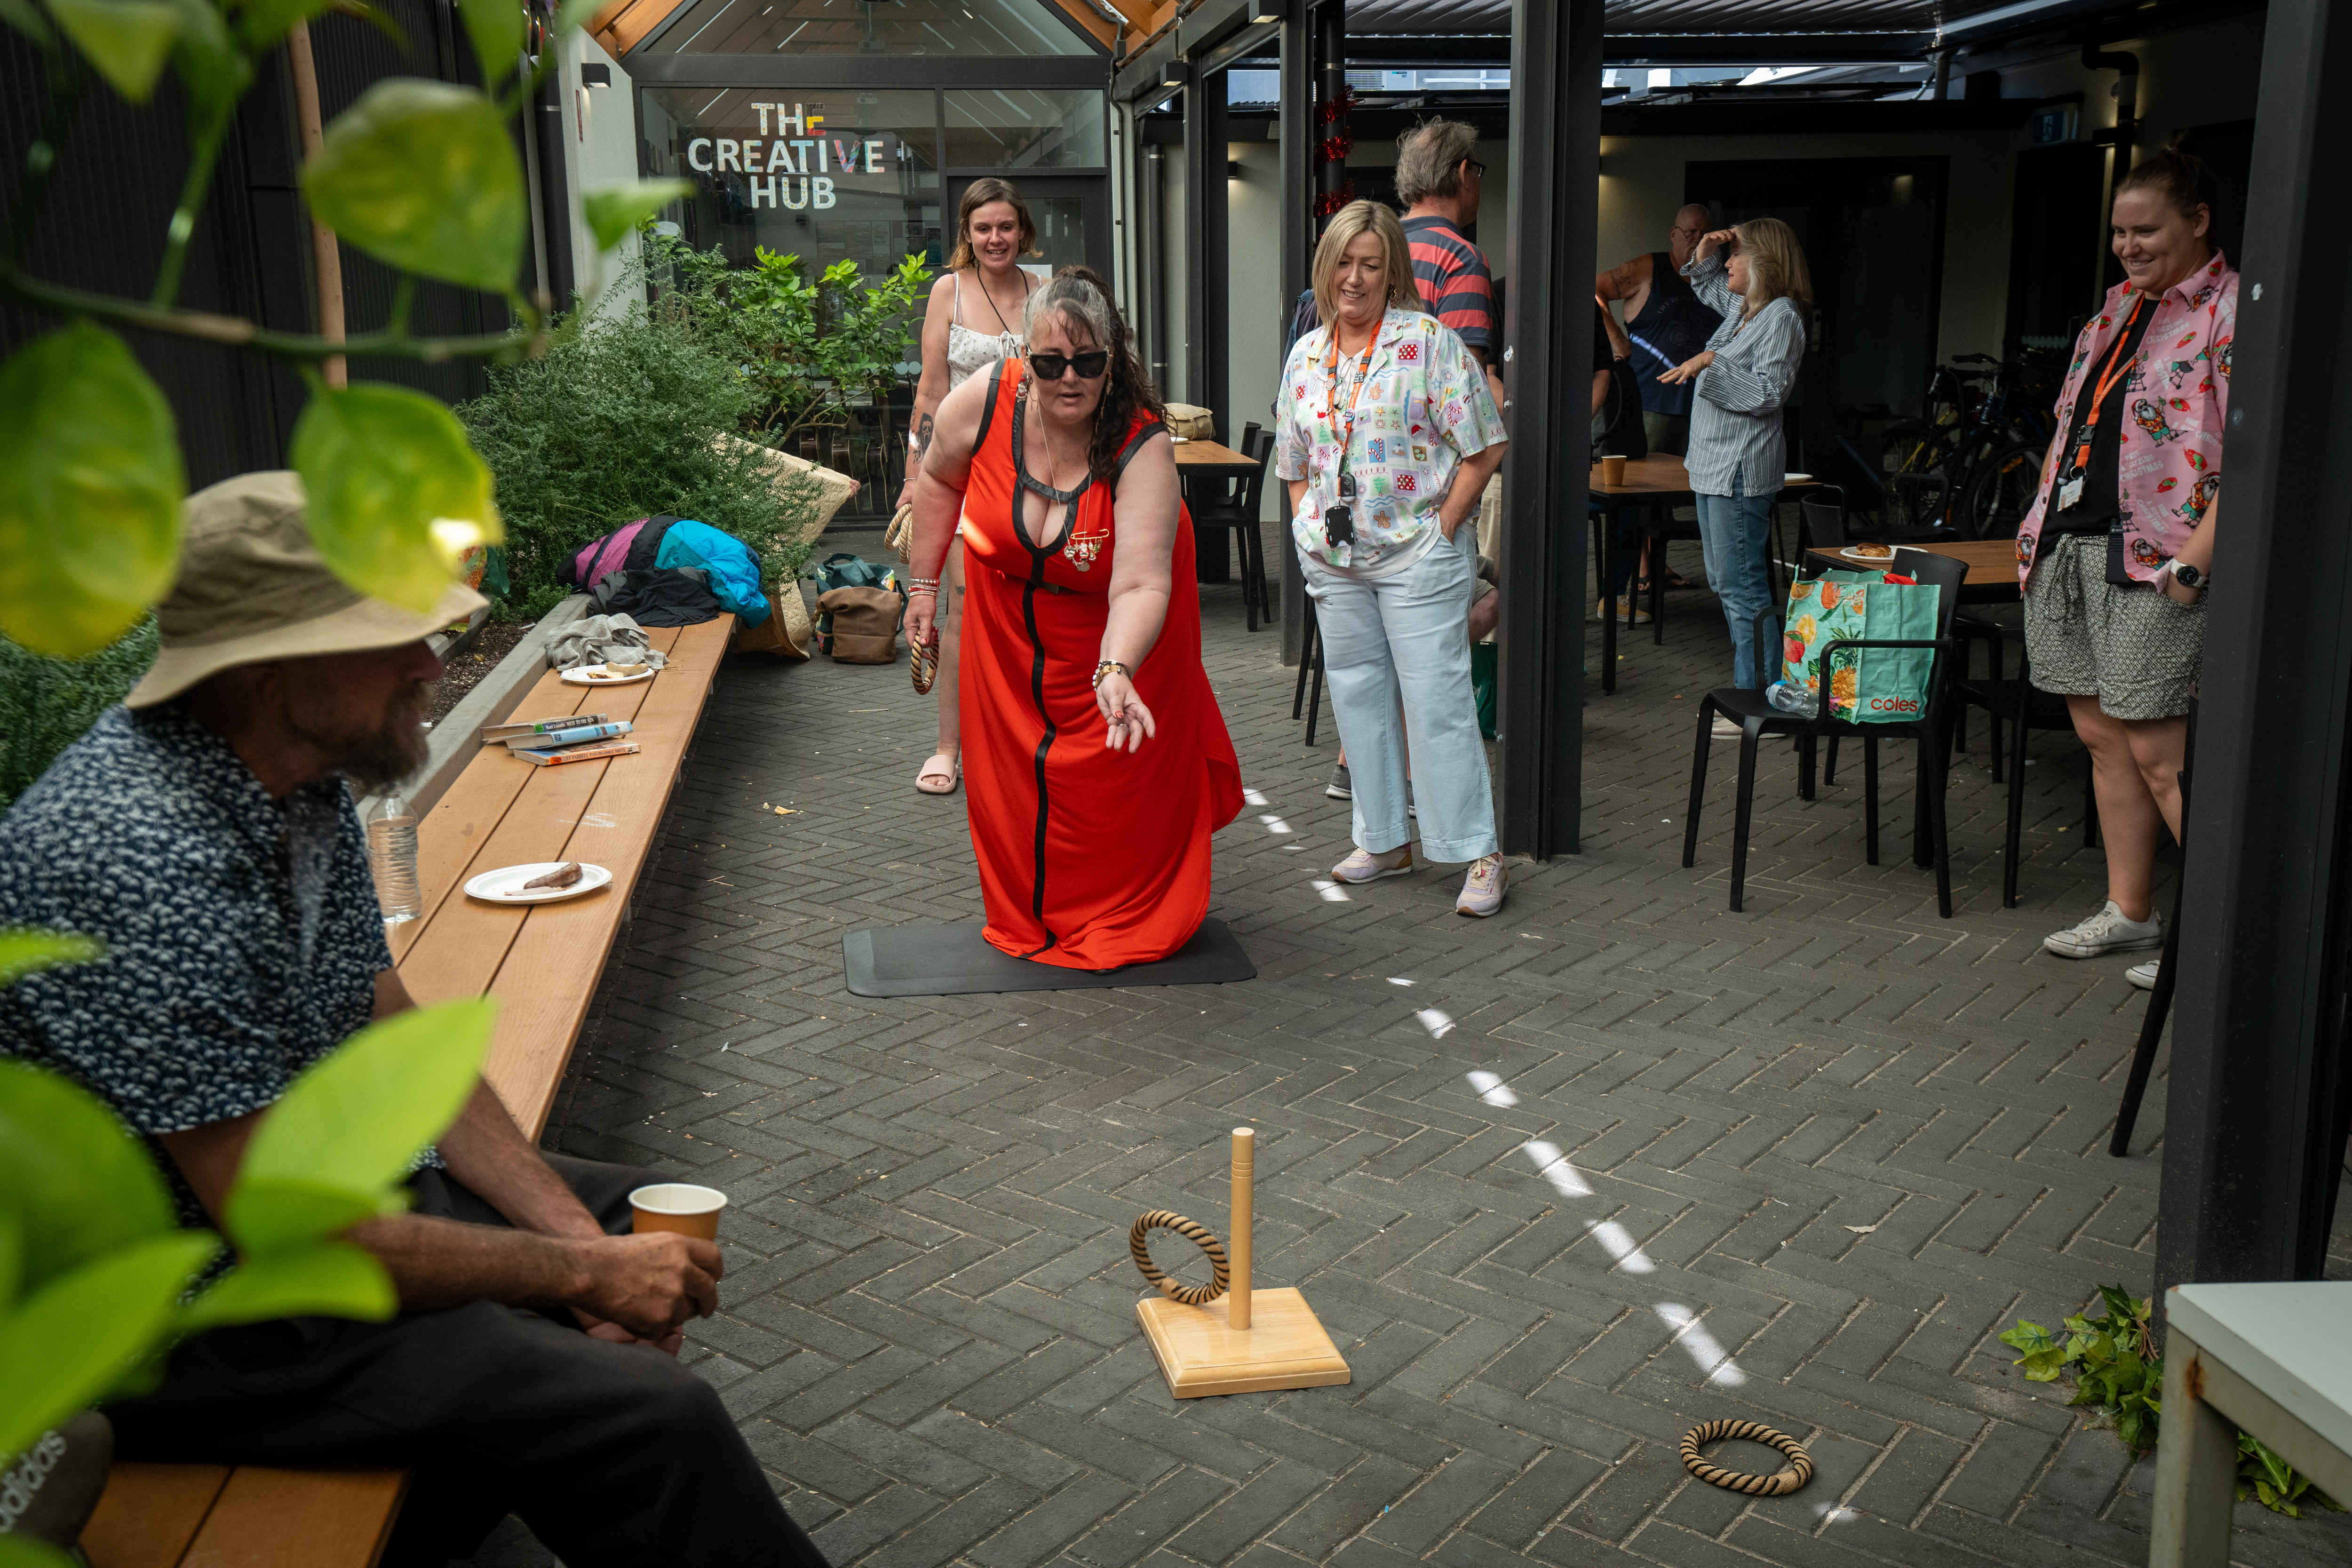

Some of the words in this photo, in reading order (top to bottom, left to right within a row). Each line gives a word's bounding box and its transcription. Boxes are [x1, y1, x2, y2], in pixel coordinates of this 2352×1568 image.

[751, 102, 826, 136] THE
[688, 138, 885, 174] CREATIVE
[751, 176, 836, 210] HUB
[2146, 321, 2190, 345] CHRISTMAS
[2185, 416, 2200, 427] HAVE
[1279, 445, 1288, 458] HO
[1280, 459, 1290, 471] HO
[2119, 460, 2164, 482] CHRISTMAS
[2129, 454, 2155, 469] SIZZLING
[1355, 512, 1367, 526] HO
[2137, 499, 2169, 535] CHRISTMAS
[1870, 696, 1918, 712] coles
